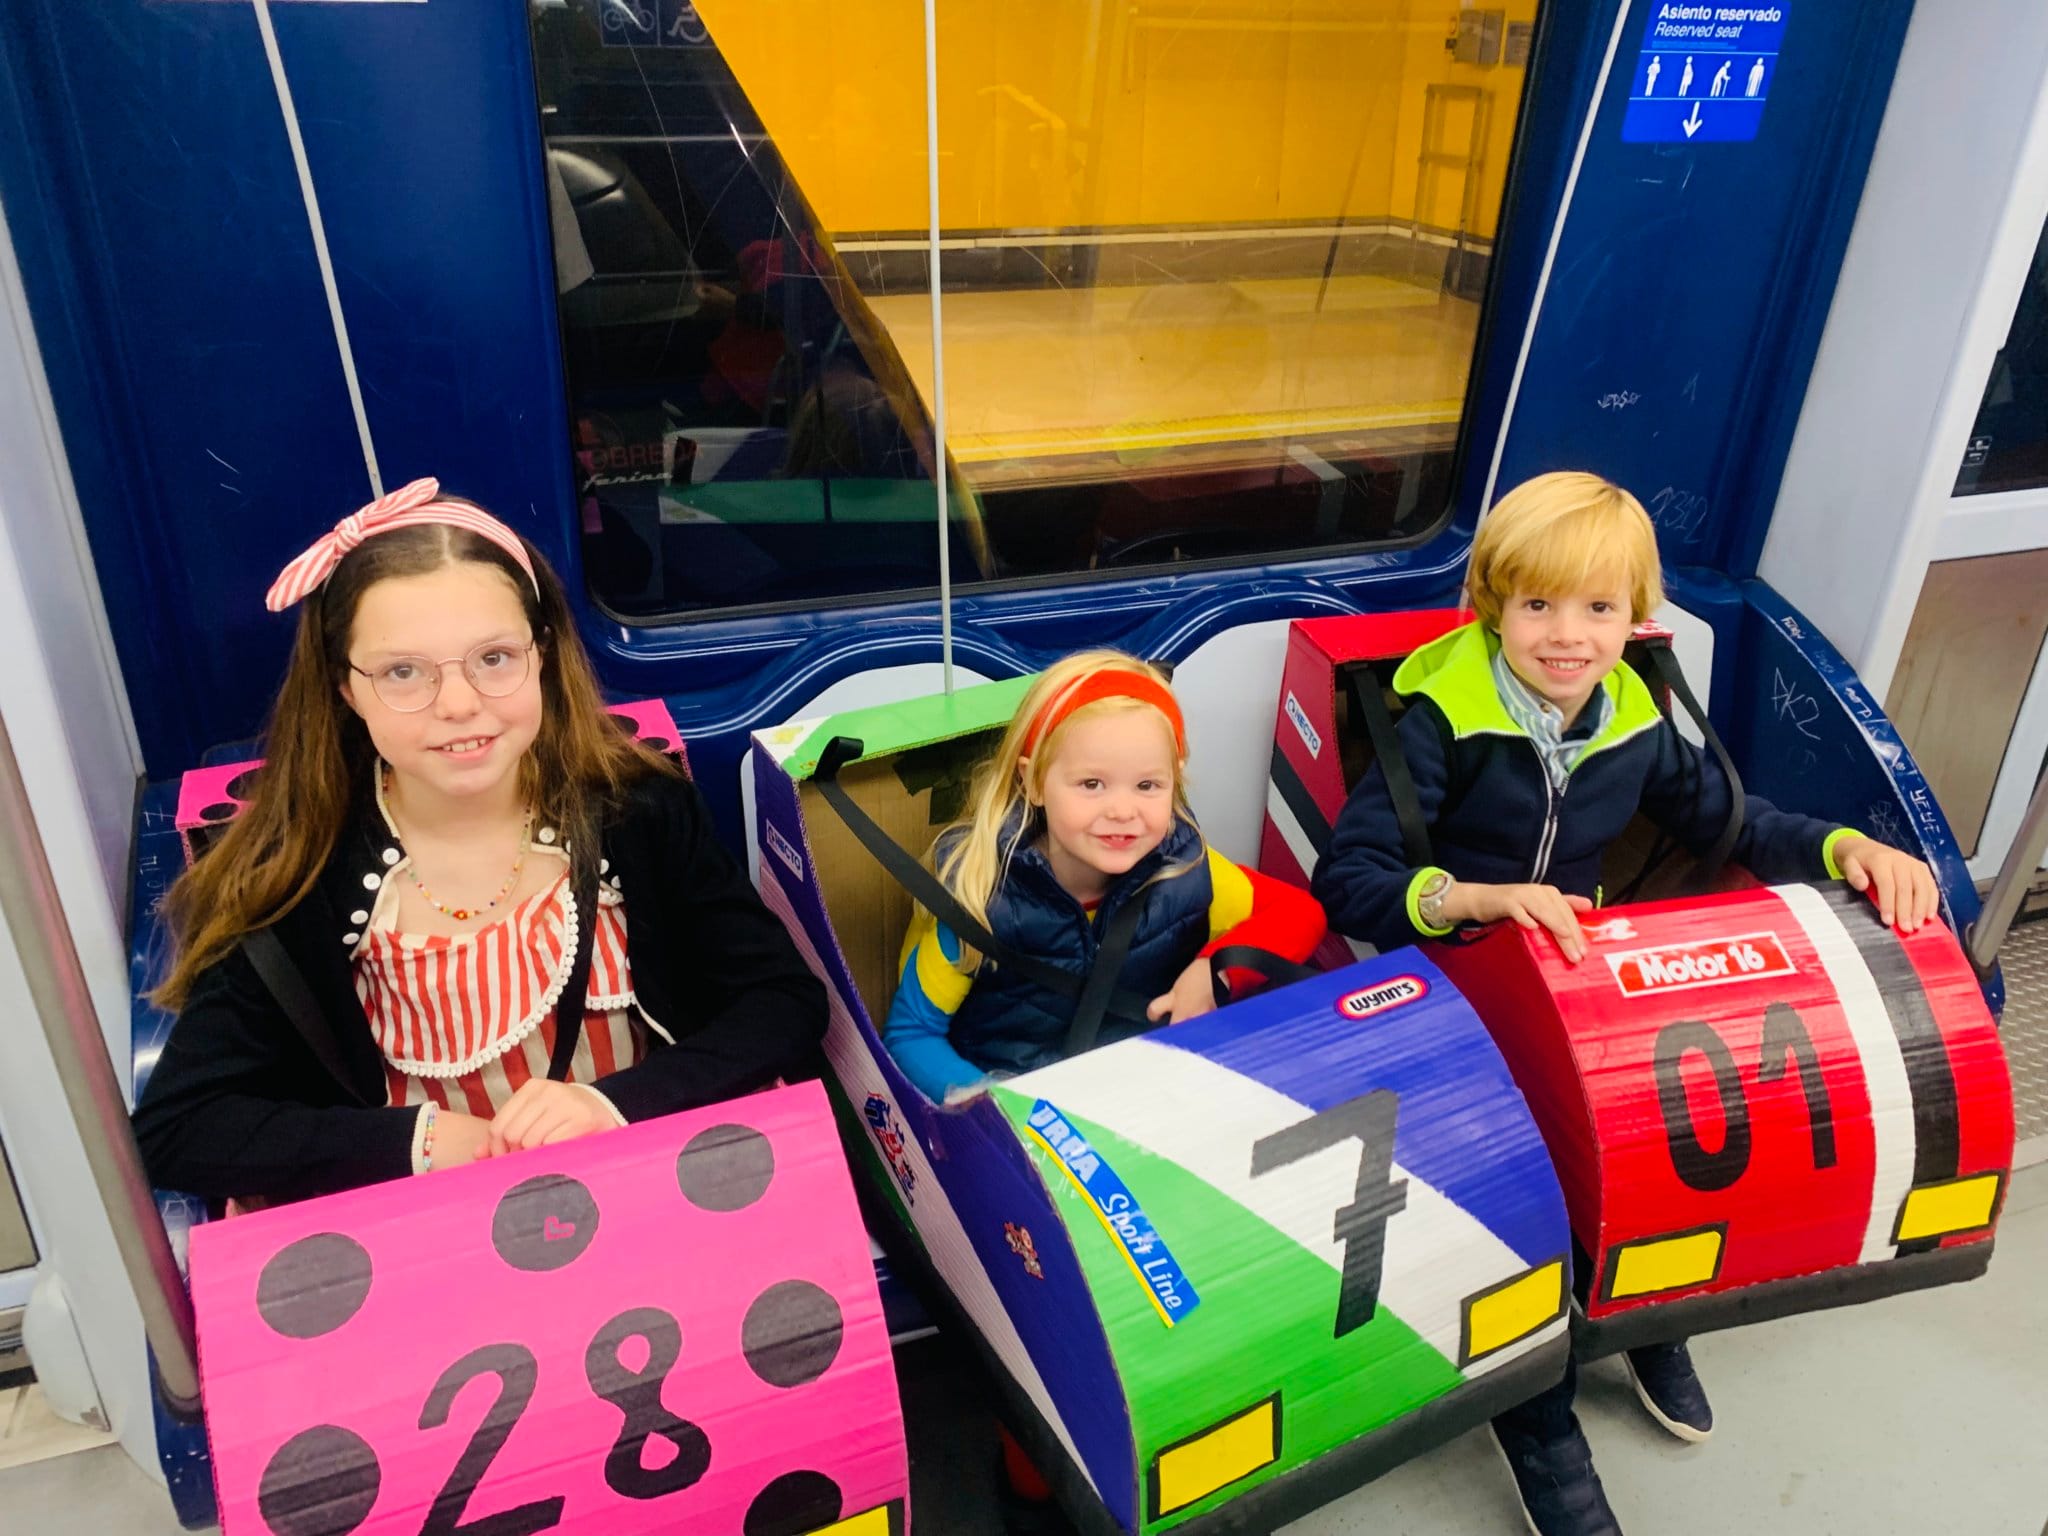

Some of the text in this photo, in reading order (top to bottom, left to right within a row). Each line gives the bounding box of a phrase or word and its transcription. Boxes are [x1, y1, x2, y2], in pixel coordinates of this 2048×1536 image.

[1654, 21, 1743, 39] Reserved seat
[1658, 3, 1782, 23] Asiento reservado
[1636, 943, 1766, 987] Motor 16
[1653, 1001, 1839, 1193] 01
[1098, 1192, 1154, 1256] Sport
[1142, 1257, 1184, 1310] Line
[1250, 1087, 1409, 1340] 7
[418, 1306, 712, 1536] 28
